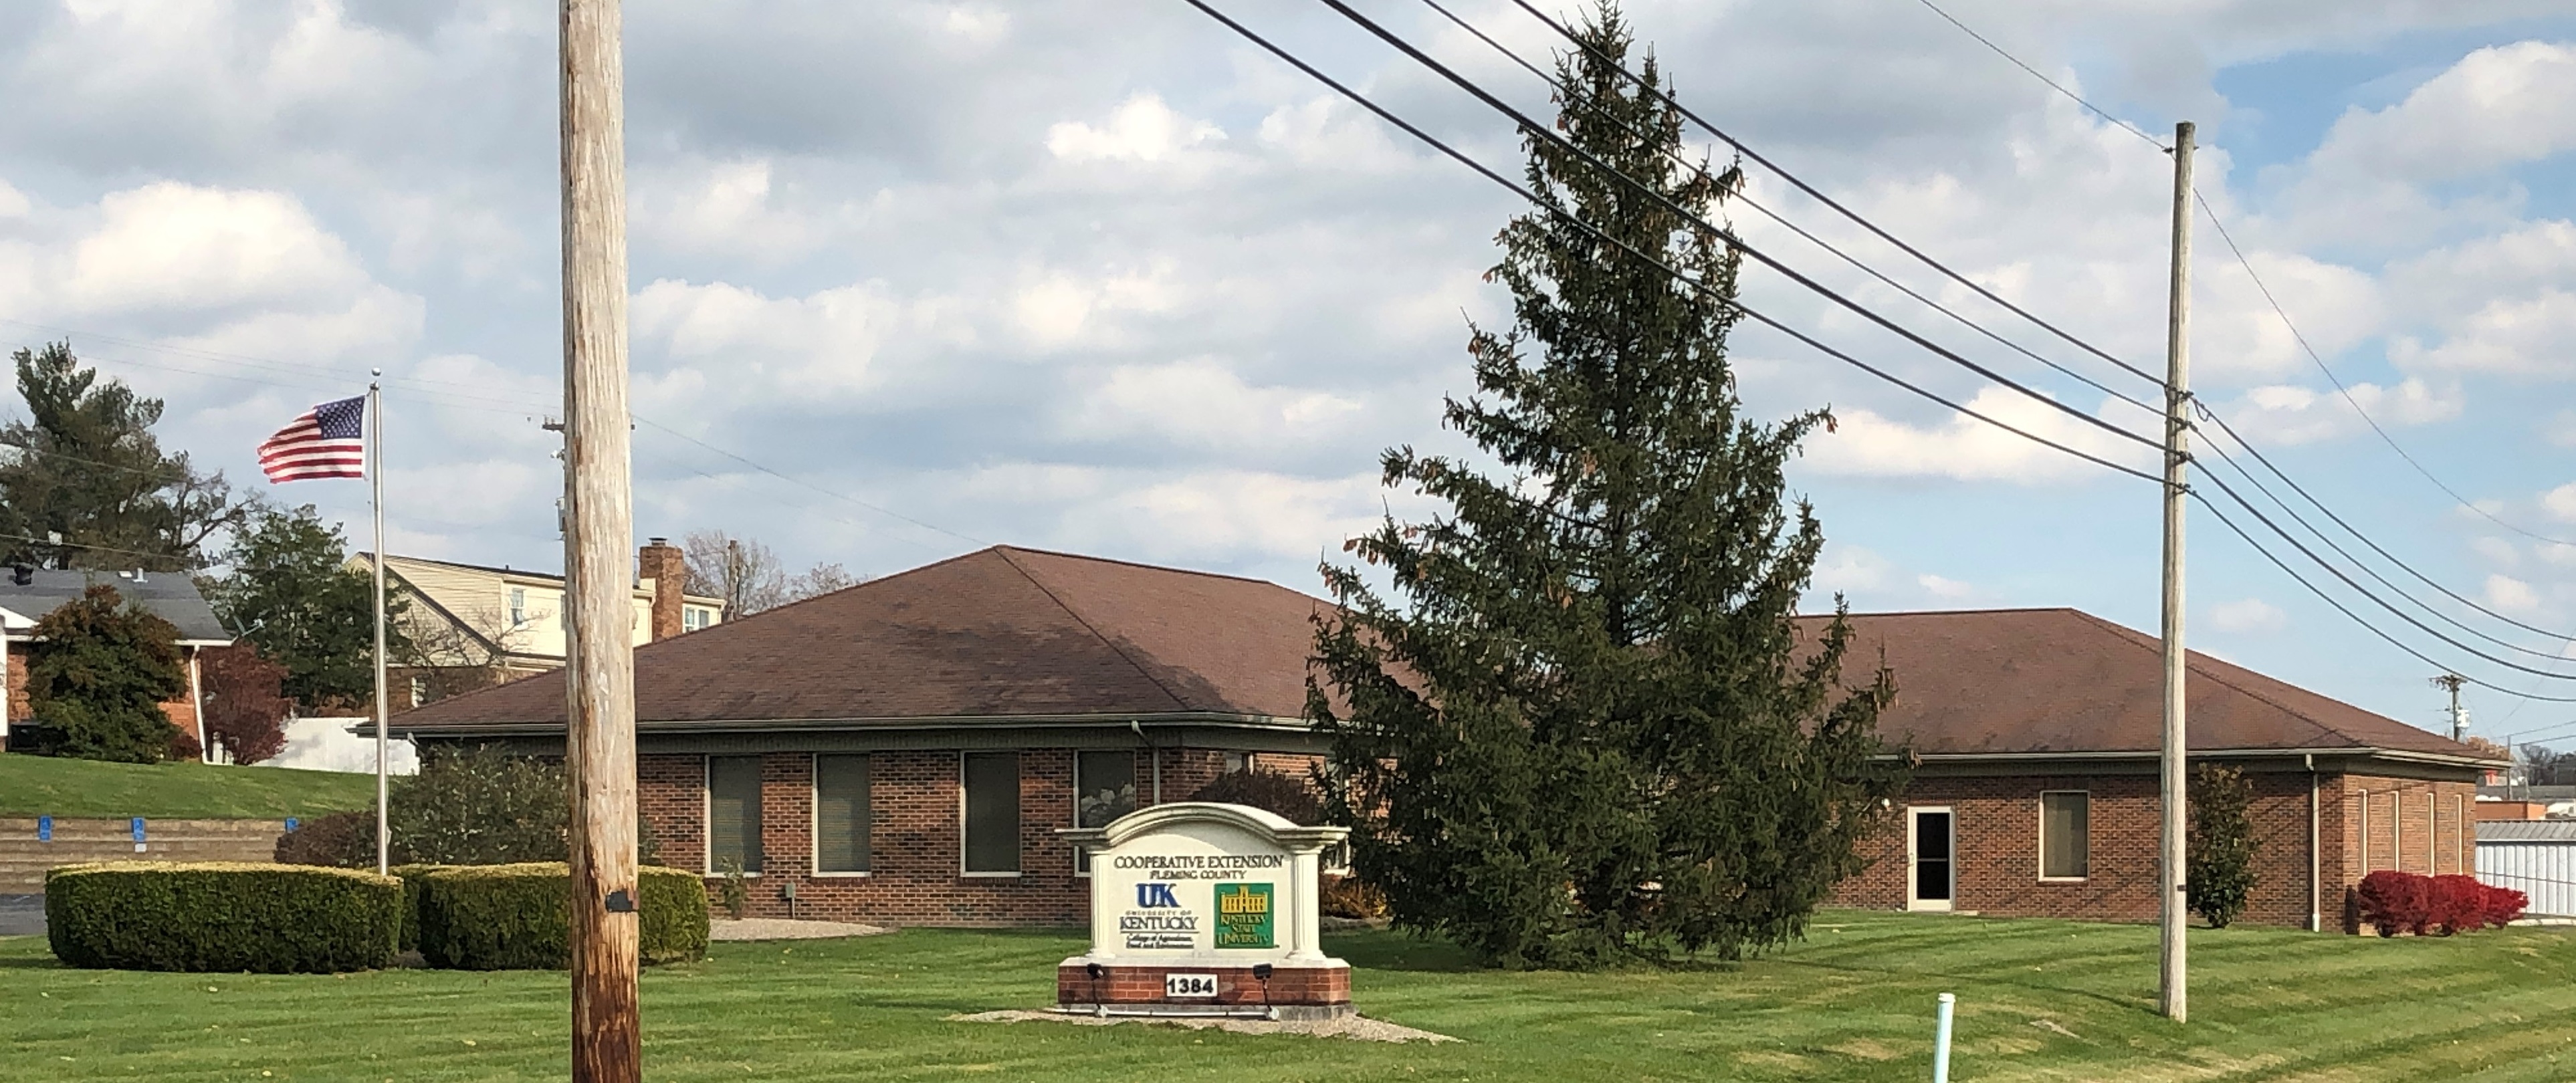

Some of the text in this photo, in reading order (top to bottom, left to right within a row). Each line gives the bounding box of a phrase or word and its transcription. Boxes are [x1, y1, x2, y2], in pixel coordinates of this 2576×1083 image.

[1114, 855, 1284, 868] COOPERATIVE EXTENSION
[1150, 870, 1247, 880] FLEMING COUNTY
[1136, 883, 1182, 908] UK
[1119, 917, 1199, 930] KENTUCKY
[1168, 978, 1214, 993] 1384
